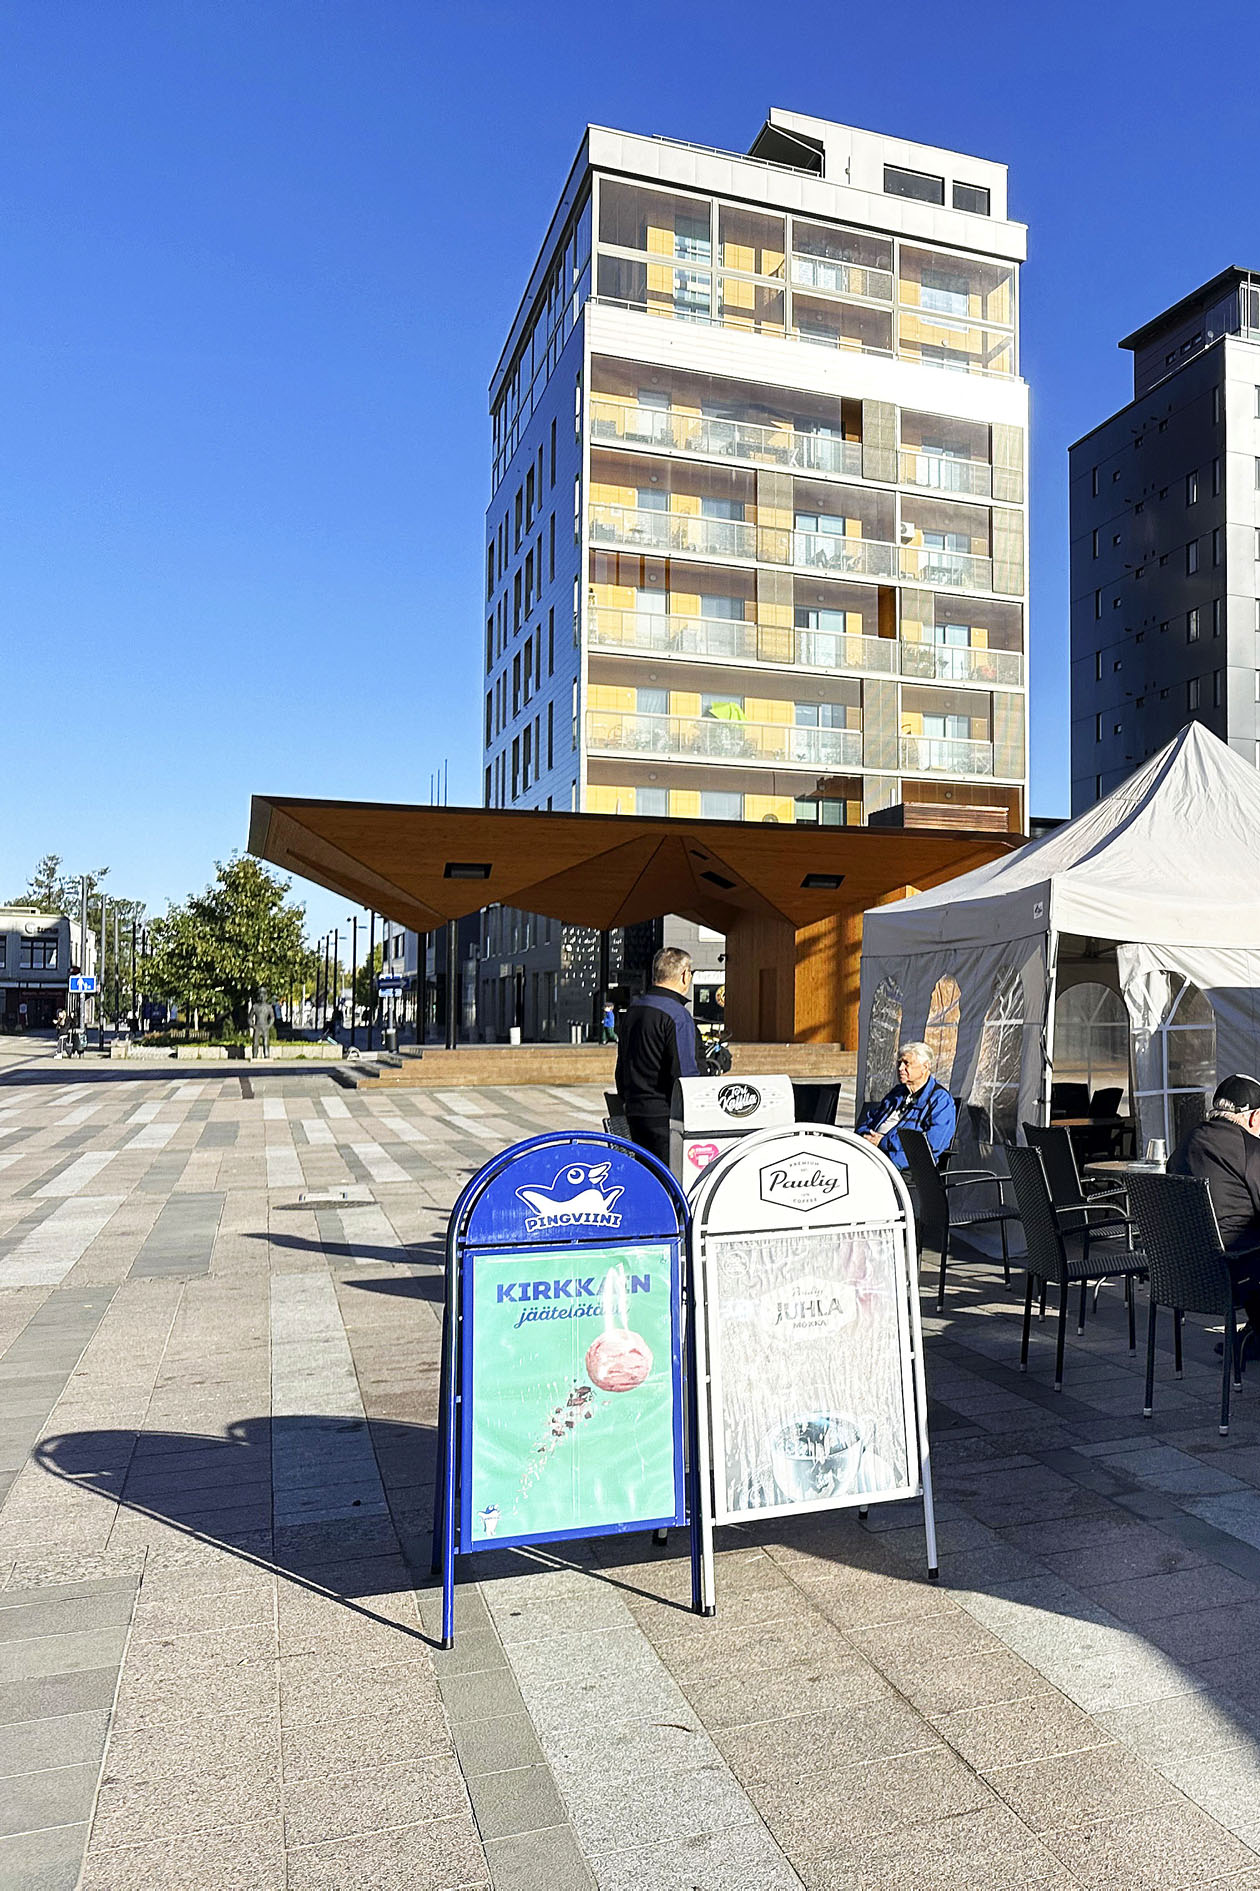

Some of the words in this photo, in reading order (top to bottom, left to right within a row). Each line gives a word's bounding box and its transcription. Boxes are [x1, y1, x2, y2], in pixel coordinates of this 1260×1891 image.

[719, 1093, 757, 1112] Kaffila
[726, 1085, 749, 1098] Tori
[769, 1169, 840, 1194] Paulig
[526, 1212, 621, 1231] PINGVIINI
[513, 1301, 632, 1329] jäätelötä
[775, 1297, 844, 1326] JUHLA
